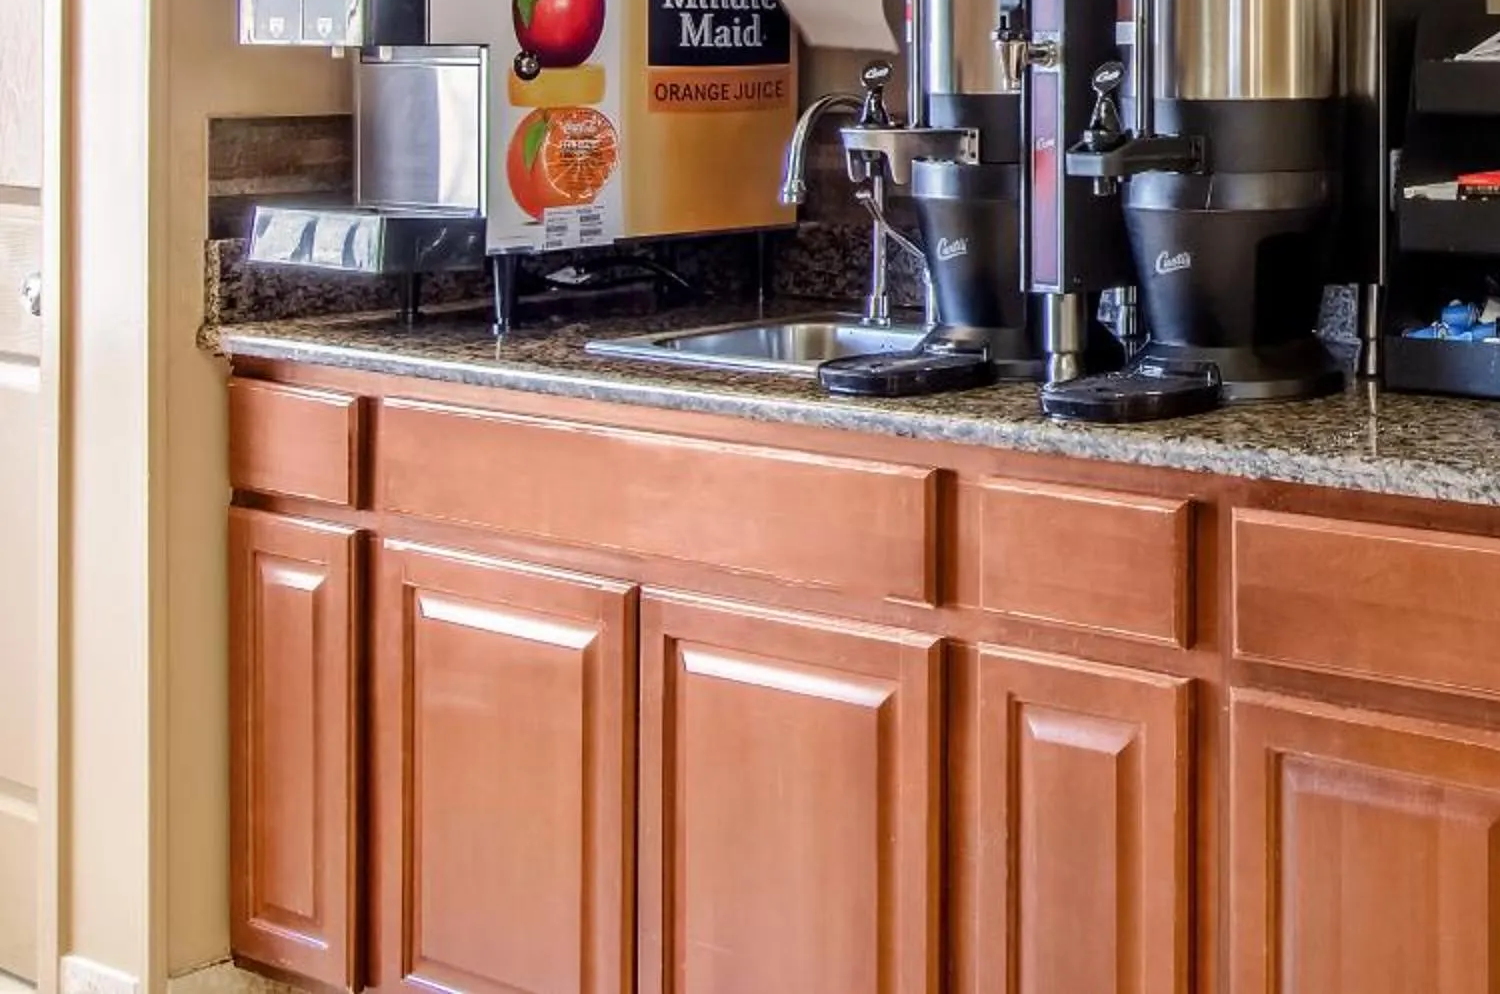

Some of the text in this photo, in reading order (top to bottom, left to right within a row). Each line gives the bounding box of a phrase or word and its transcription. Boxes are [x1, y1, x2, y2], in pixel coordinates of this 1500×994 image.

[679, 12, 762, 48] Maid
[655, 80, 785, 102] ORANGE JUICE
